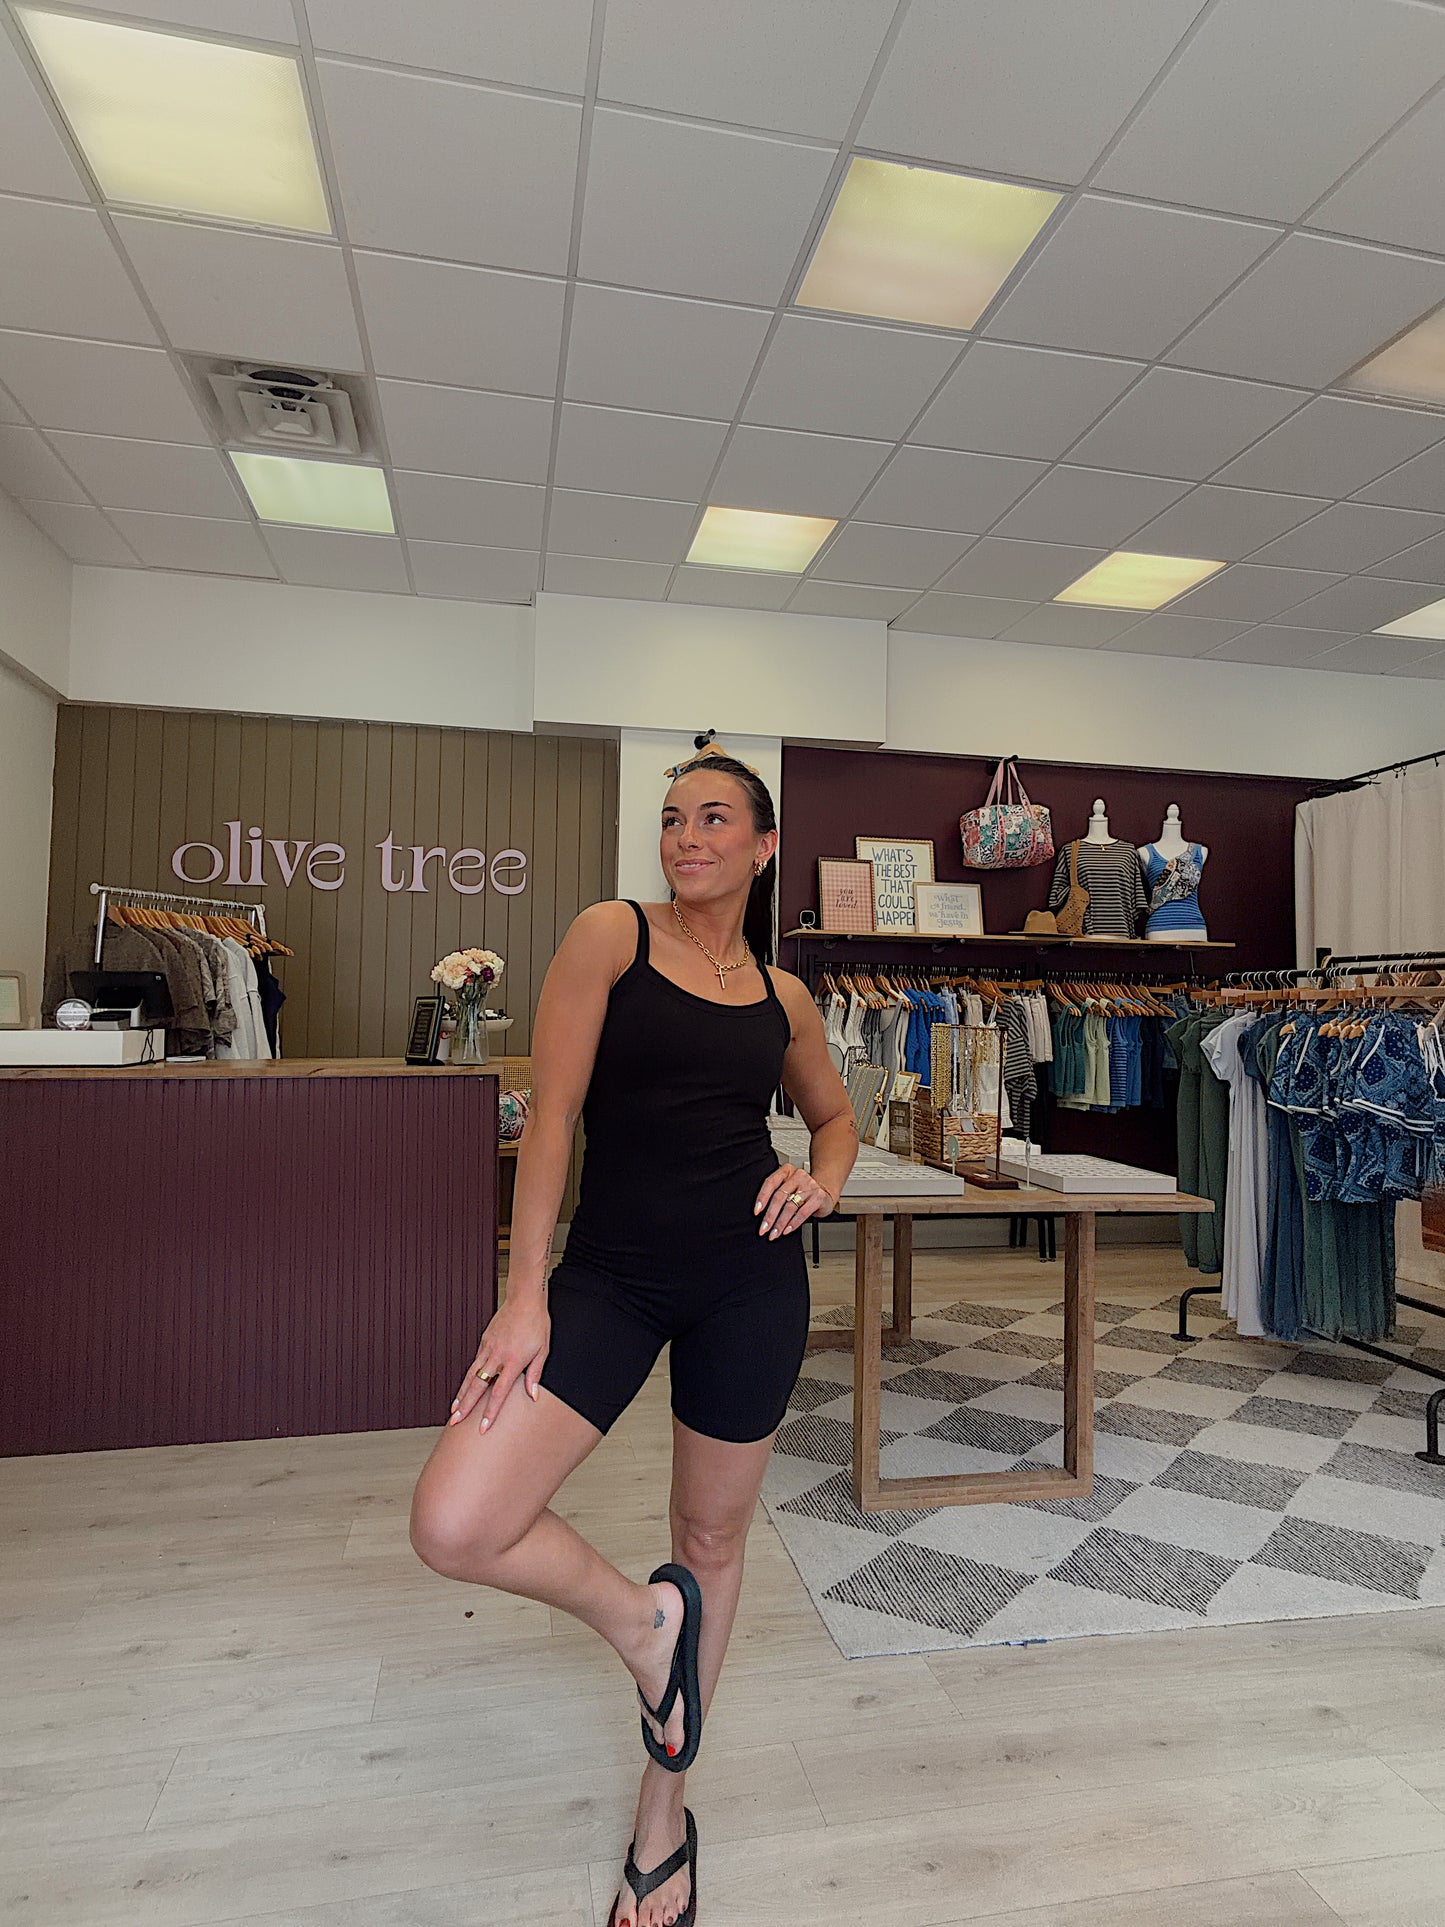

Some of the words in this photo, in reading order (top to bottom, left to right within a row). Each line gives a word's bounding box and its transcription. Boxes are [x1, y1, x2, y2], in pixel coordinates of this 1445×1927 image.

[171, 821, 346, 891] olive
[375, 830, 528, 895] tree
[872, 847, 914, 862] WHAT'S
[874, 863, 892, 878] THE
[893, 863, 918, 878] BEST
[837, 888, 854, 897] you
[880, 879, 912, 894] THAT
[840, 894, 854, 902] are
[878, 894, 915, 910] COULD
